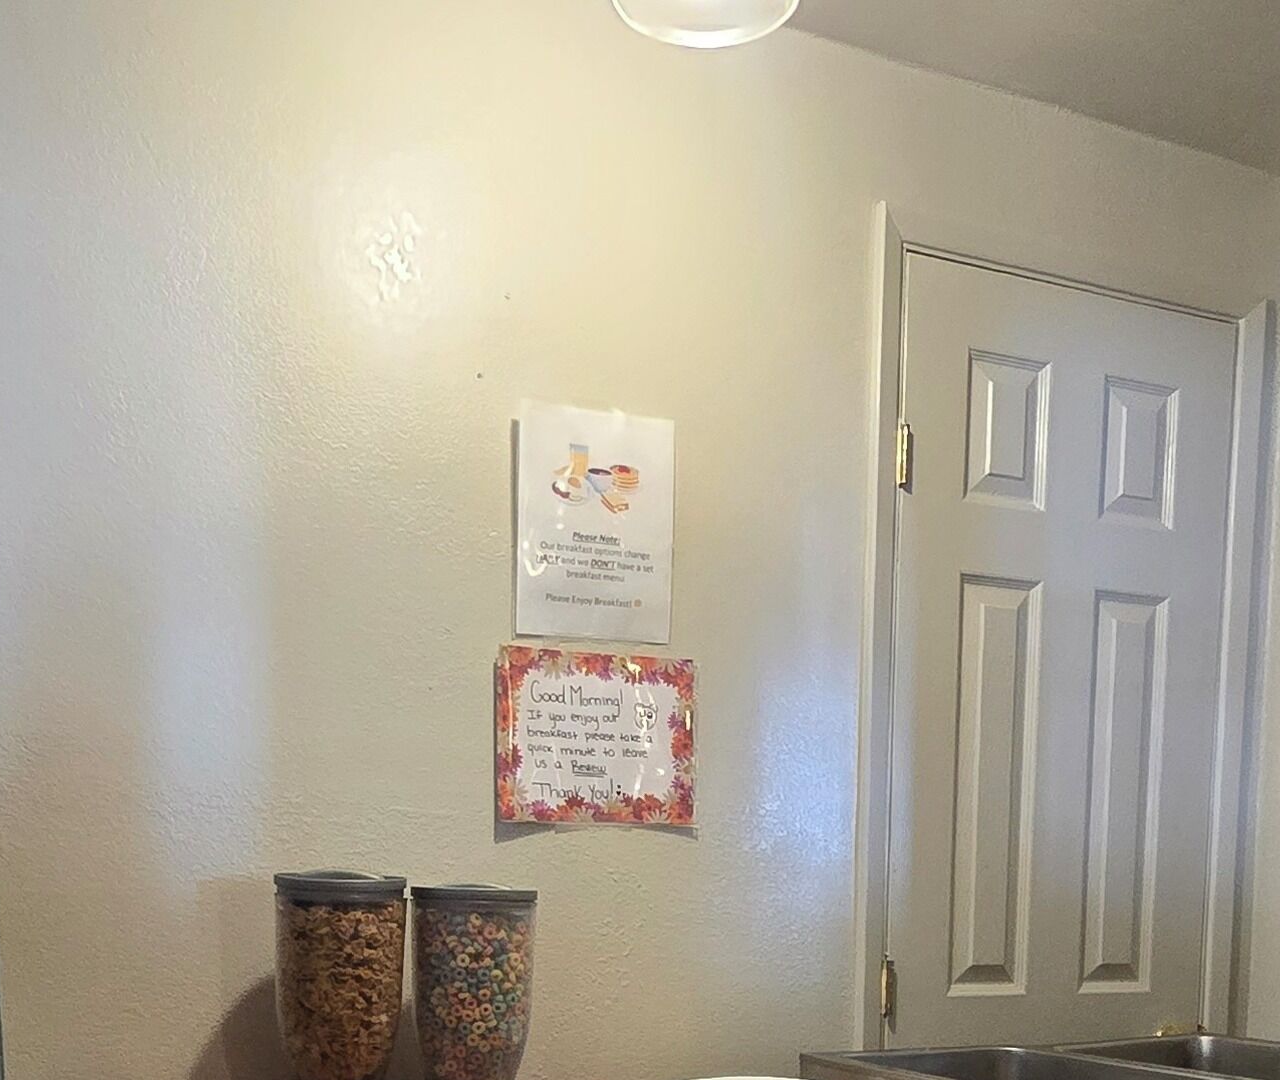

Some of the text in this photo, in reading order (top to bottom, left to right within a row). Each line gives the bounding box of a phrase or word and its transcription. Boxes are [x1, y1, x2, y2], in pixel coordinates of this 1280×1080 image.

[573, 532, 597, 543] Please
[540, 541, 650, 561] Our breakfast options change
[561, 556, 575, 565] and
[577, 559, 589, 567] we
[591, 559, 616, 570] DON'T
[617, 562, 635, 571] have
[643, 565, 654, 573] set
[566, 570, 625, 582] breakfast menu
[545, 592, 570, 603] Please
[572, 595, 593, 606] Enjoy
[530, 680, 623, 717] Good Morning!
[527, 709, 619, 731] If you enjoy our
[527, 725, 653, 744] breakfast please take a
[527, 743, 649, 758] quick minute to leave
[535, 759, 548, 769] us
[554, 760, 562, 769] a
[532, 778, 614, 803] Thank You!
